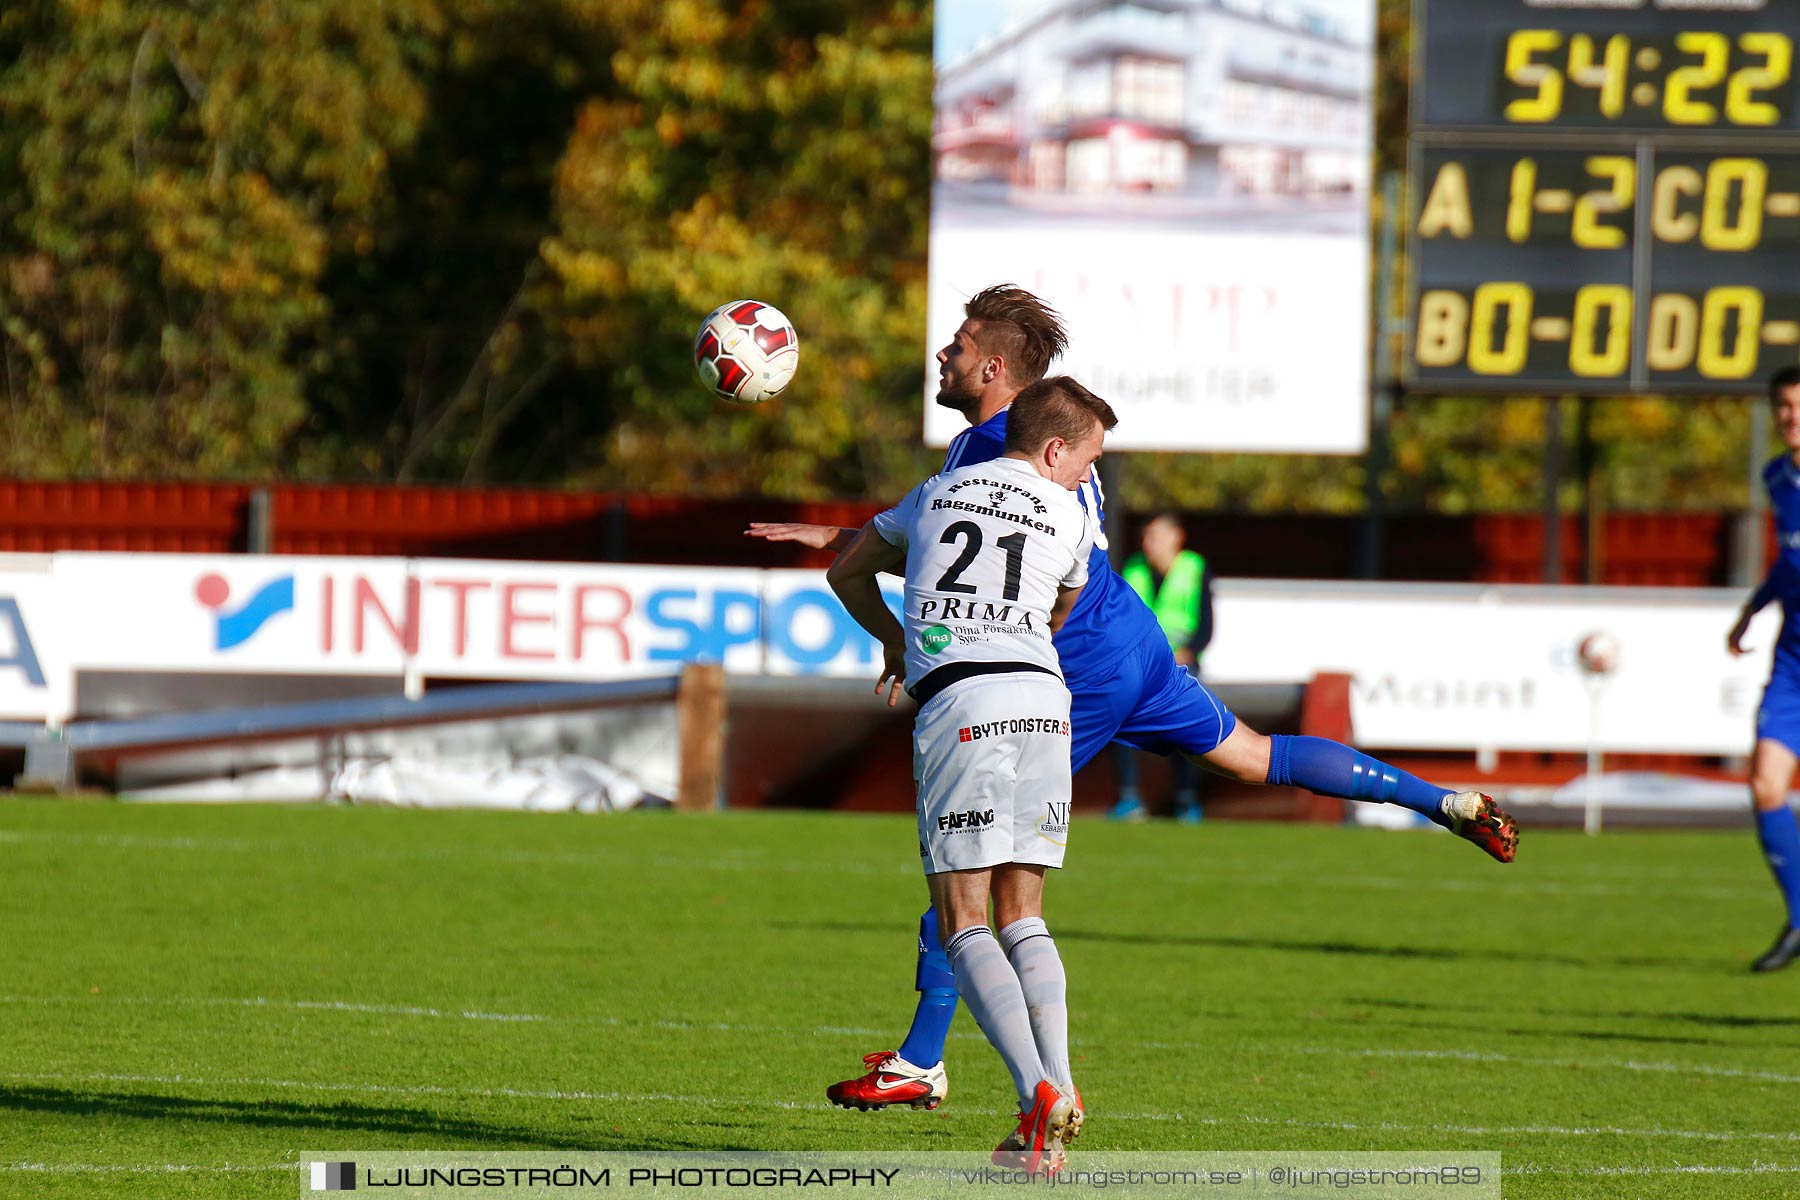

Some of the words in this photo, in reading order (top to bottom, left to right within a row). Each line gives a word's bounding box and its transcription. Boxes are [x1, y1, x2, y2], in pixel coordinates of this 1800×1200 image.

[1504, 29, 1793, 126] 54:22
[1417, 161, 1474, 239] A
[1505, 155, 1637, 249] 1-2
[1652, 165, 1703, 243] C
[1415, 289, 1469, 367] B
[1467, 281, 1633, 377] 0-0
[1647, 293, 1699, 371] D
[931, 498, 1056, 537] Raggmunken
[948, 478, 1047, 515] Restaurang
[935, 520, 1028, 602] 21
[919, 598, 1033, 631] PRIMA
